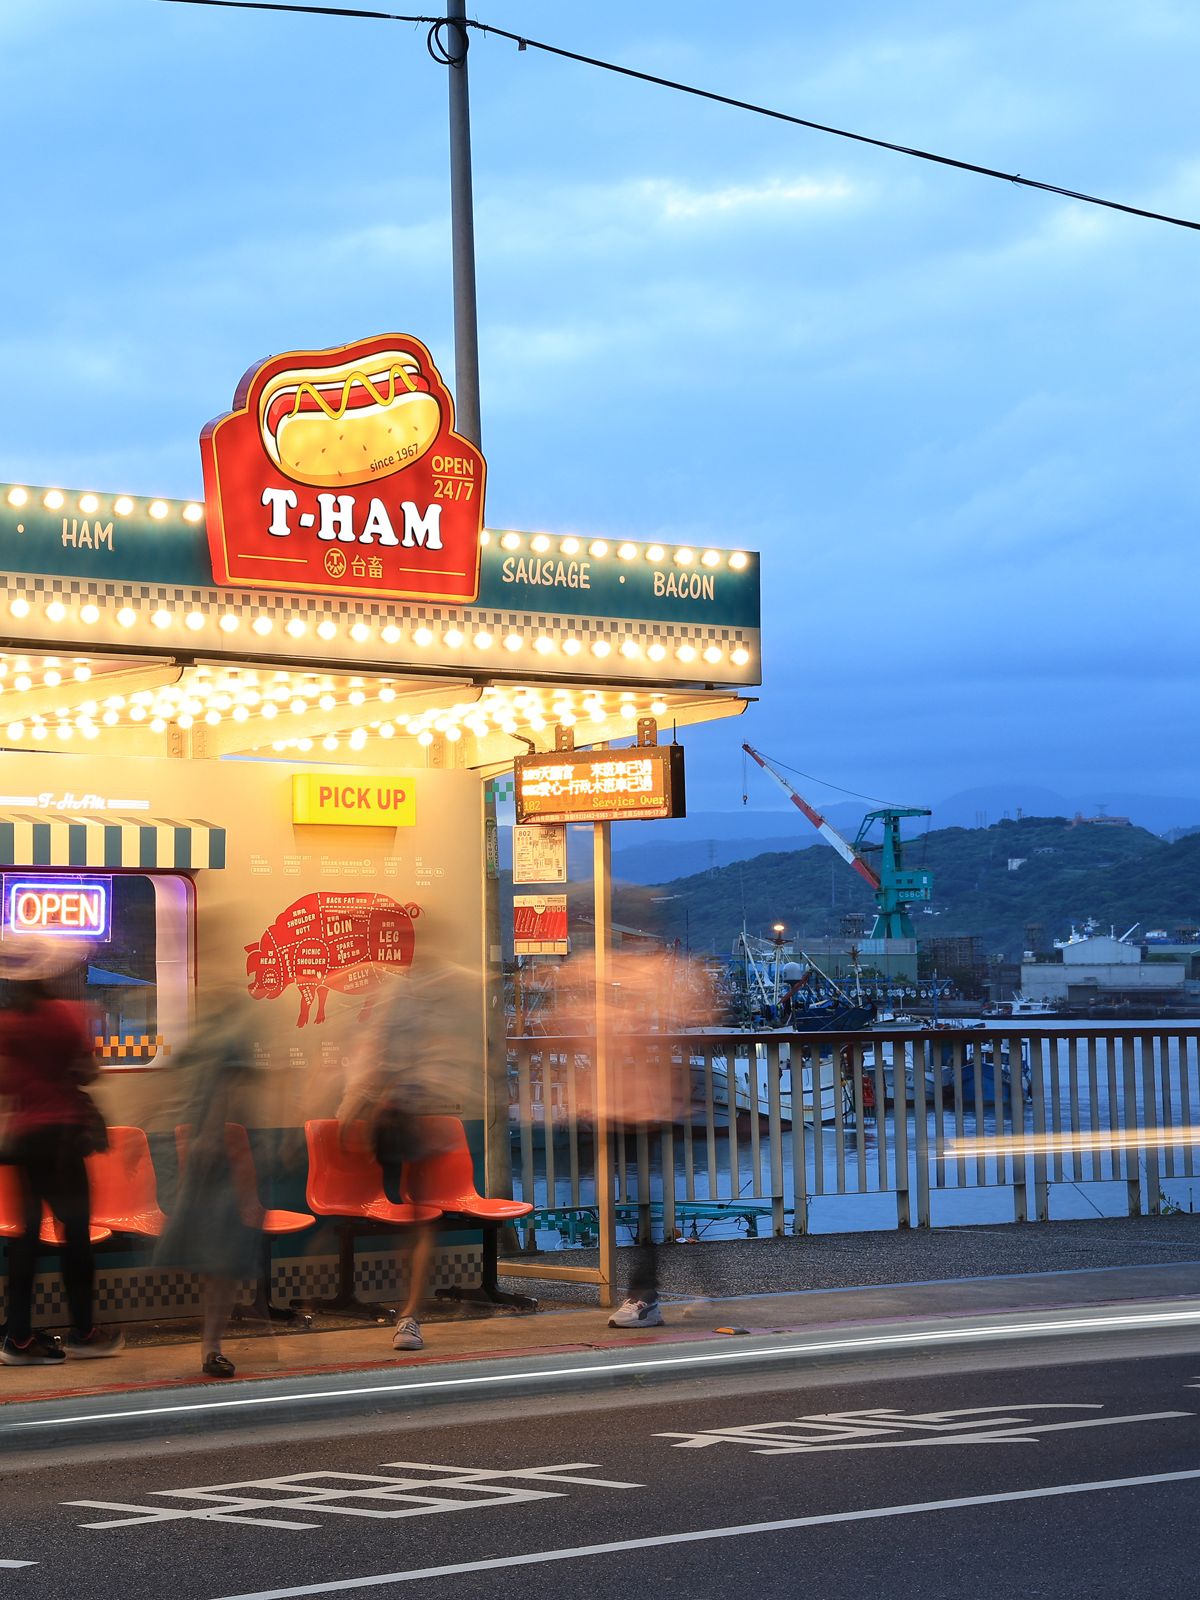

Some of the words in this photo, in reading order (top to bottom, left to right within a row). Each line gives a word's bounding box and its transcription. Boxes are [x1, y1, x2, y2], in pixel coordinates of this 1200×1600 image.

[370, 455, 395, 473] since
[396, 443, 420, 462] 1967
[431, 455, 474, 476] OPEN
[433, 479, 474, 501] 24/7
[261, 487, 444, 550] T-HAM
[61, 518, 115, 552] HAM
[351, 554, 383, 579] 台畜
[502, 557, 591, 590] SAUSAGE
[653, 571, 715, 602] BACON
[318, 785, 371, 811] PICK
[377, 786, 407, 812] UP
[524, 800, 541, 812] 102
[592, 797, 635, 808] Service
[639, 794, 665, 805] Over
[17, 893, 99, 927] OPEN
[287, 914, 316, 928] SHOULDER
[295, 925, 311, 936] BUTT
[326, 919, 353, 937] LOIN
[336, 941, 354, 951] SPARE
[379, 931, 400, 943] LEG
[301, 948, 321, 956] PICNIC
[378, 948, 401, 961] HAM
[284, 953, 293, 978] NECK
[348, 969, 369, 982] BELLY
